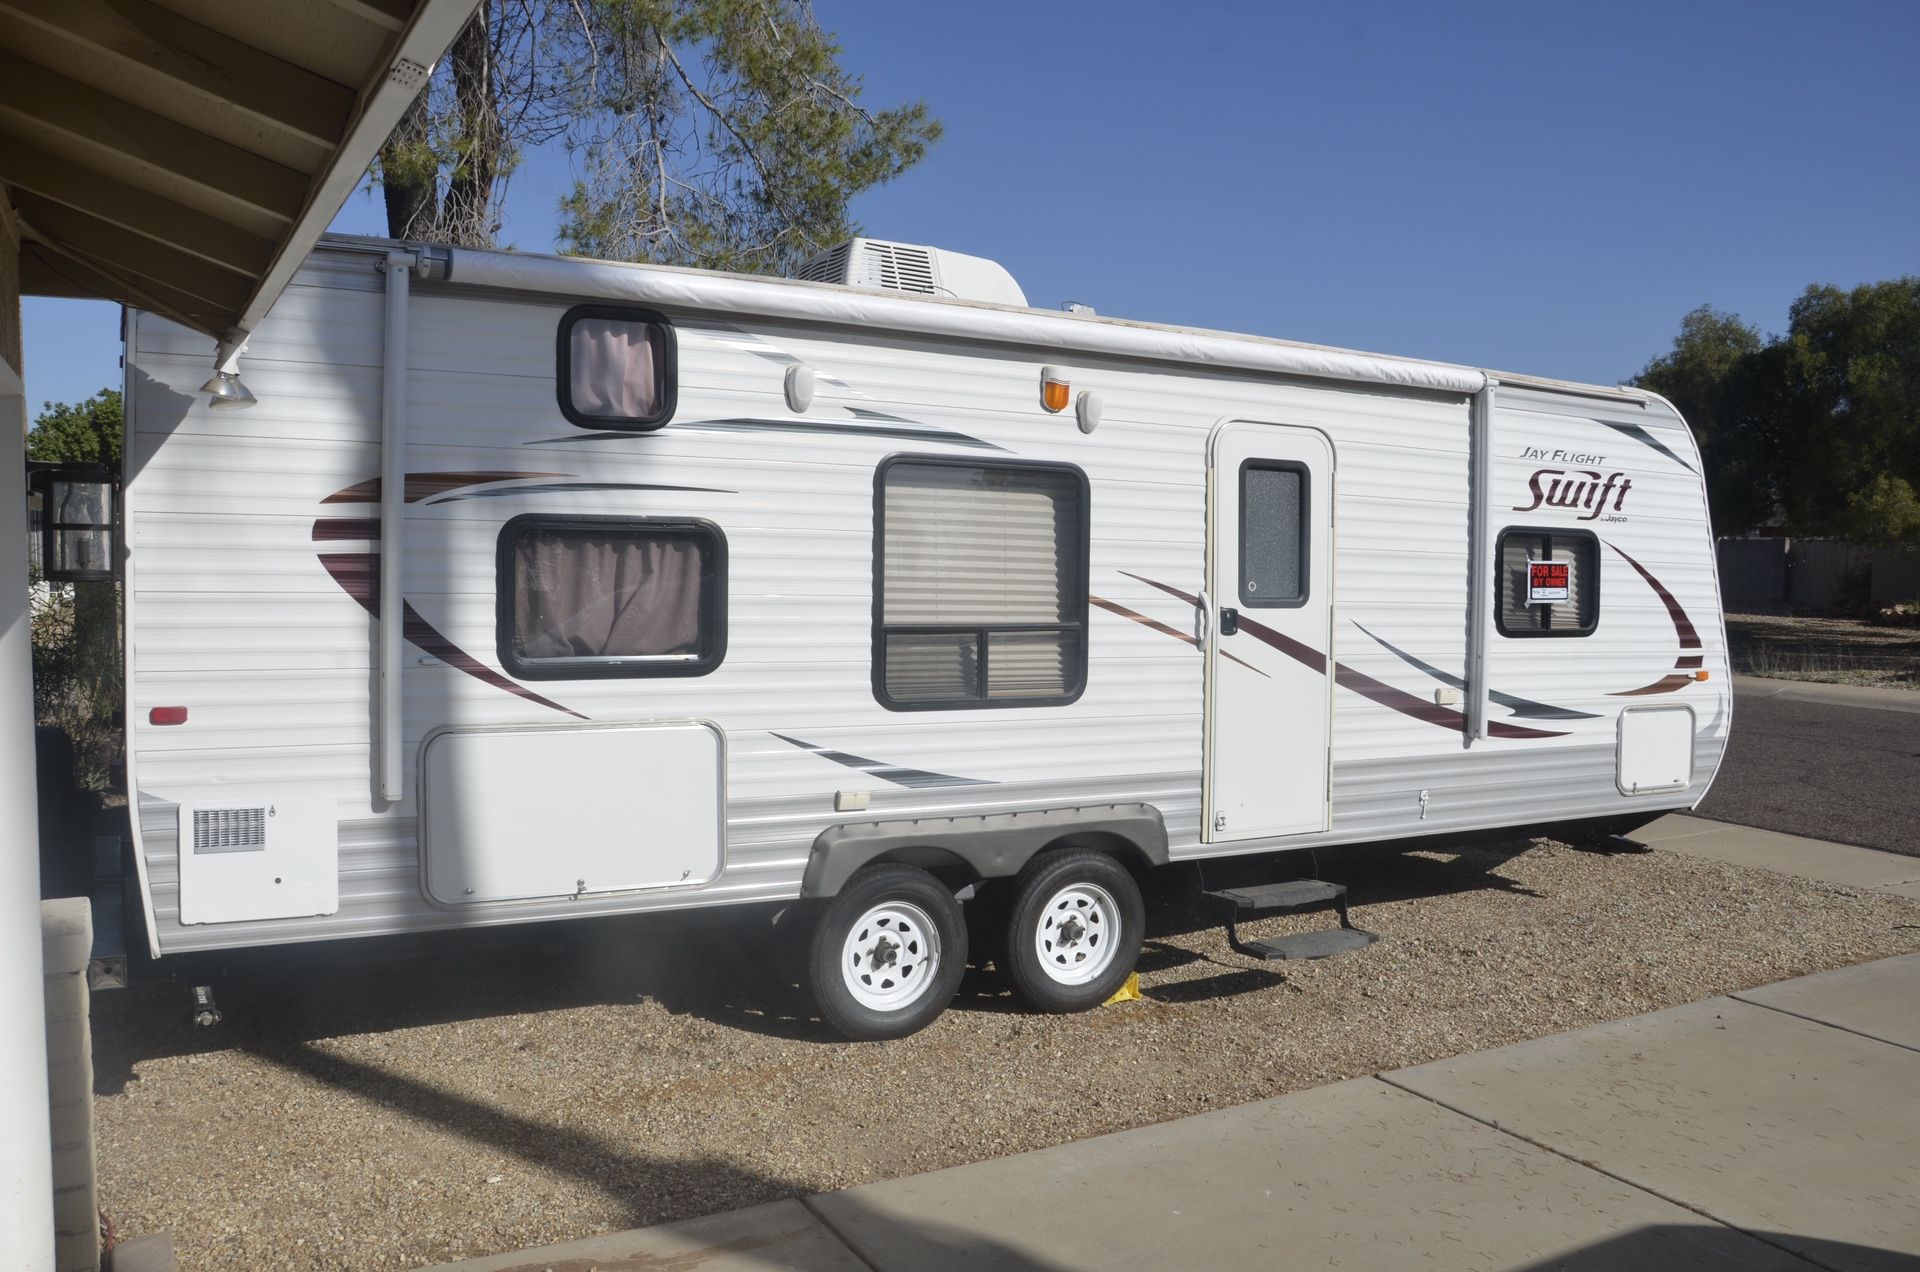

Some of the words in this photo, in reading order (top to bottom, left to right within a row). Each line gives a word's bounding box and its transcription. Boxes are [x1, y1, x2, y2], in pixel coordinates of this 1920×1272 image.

[1520, 447, 1548, 459] JAY
[1551, 450, 1606, 465] FLIGHT
[1512, 469, 1632, 520] Swift
[1605, 514, 1627, 524] Jayco
[1531, 565, 1549, 577] FOR
[1551, 565, 1568, 577] SALE
[1533, 577, 1543, 586] BY
[1545, 577, 1566, 587] OWNER
